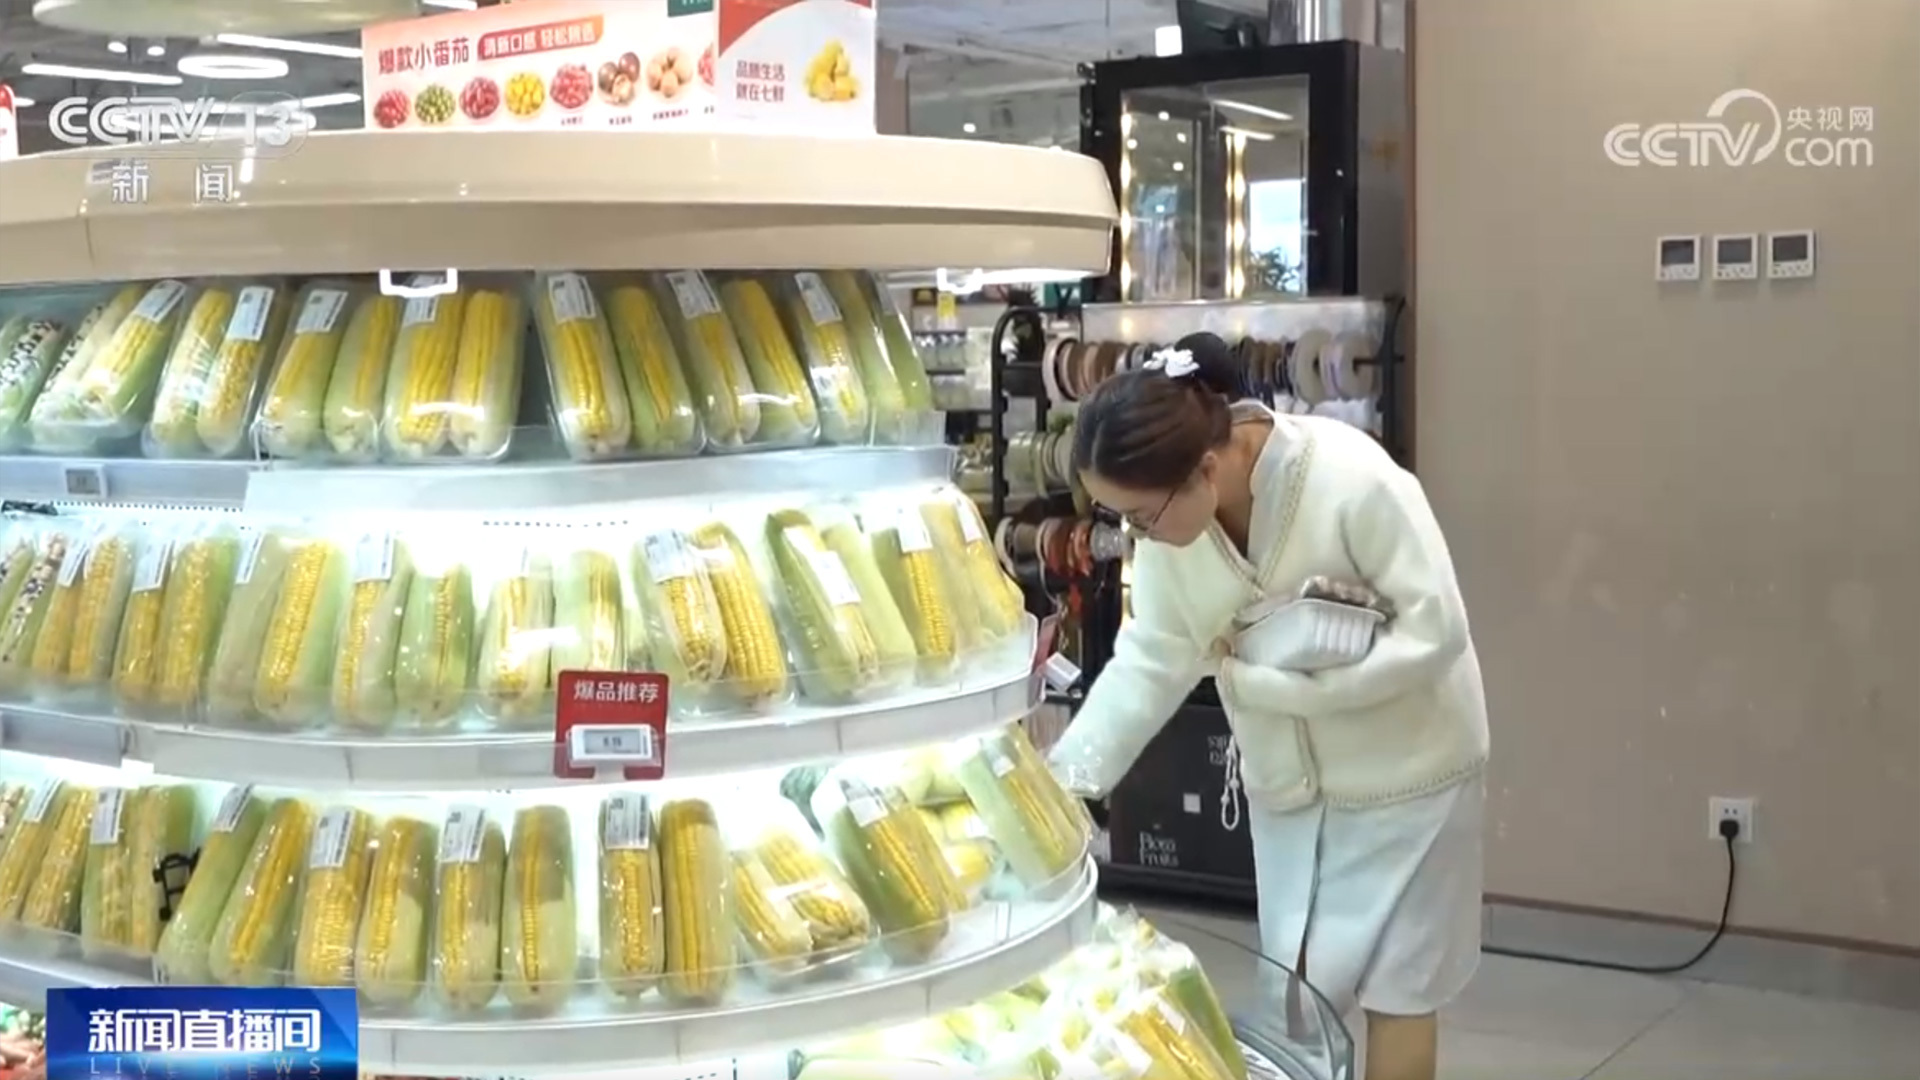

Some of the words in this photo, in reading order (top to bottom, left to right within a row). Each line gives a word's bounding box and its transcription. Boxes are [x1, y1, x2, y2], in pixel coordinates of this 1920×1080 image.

[378, 37, 469, 74] 爆款小番茄
[573, 680, 659, 703] 爆品推荐
